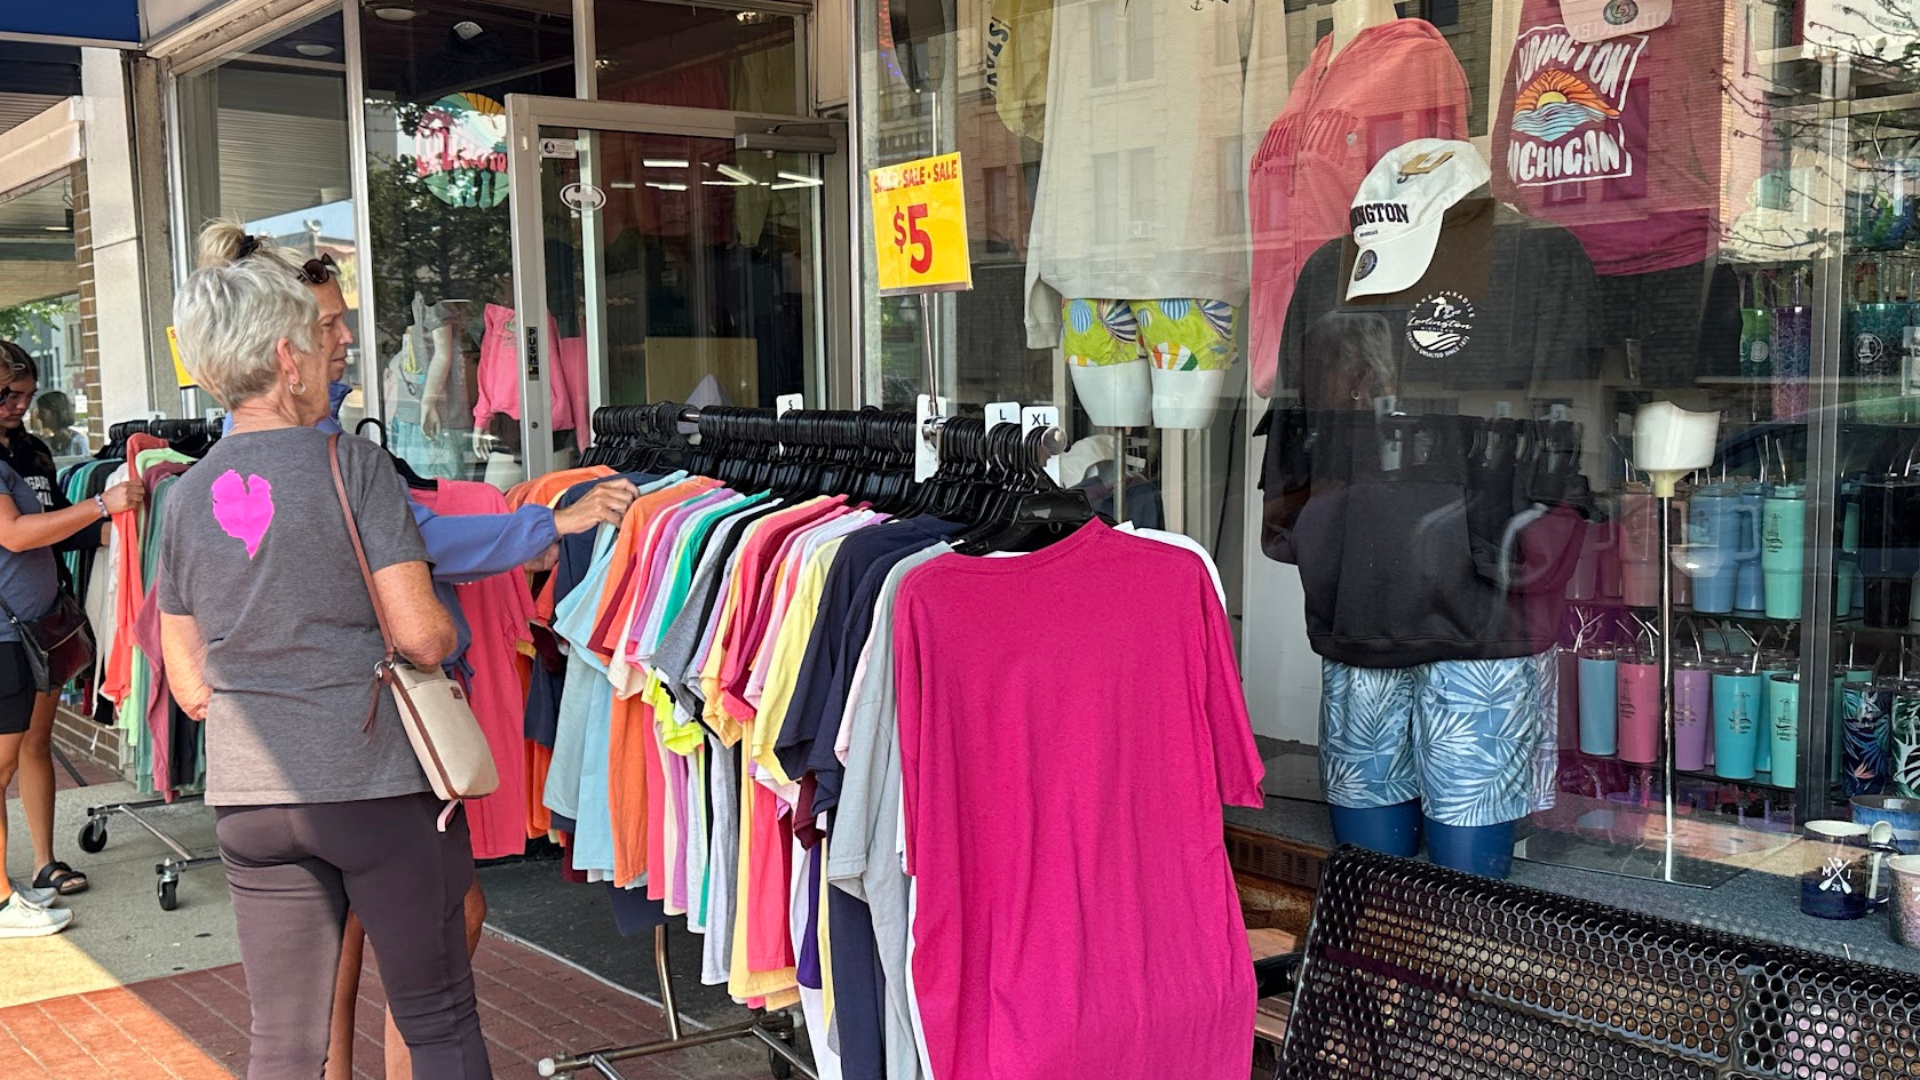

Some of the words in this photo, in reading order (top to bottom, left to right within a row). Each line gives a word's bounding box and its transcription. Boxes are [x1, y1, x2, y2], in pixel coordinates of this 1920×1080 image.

[873, 170, 896, 193] SALE
[903, 166, 925, 188] SALE
[933, 160, 957, 182] SALE
[893, 203, 933, 274] $5
[1439, 290, 1475, 318] PARADISE
[1407, 316, 1473, 330] Ludington
[529, 328, 538, 363] PUSH
[1000, 409, 1007, 420] L
[1032, 413, 1051, 425] XL
